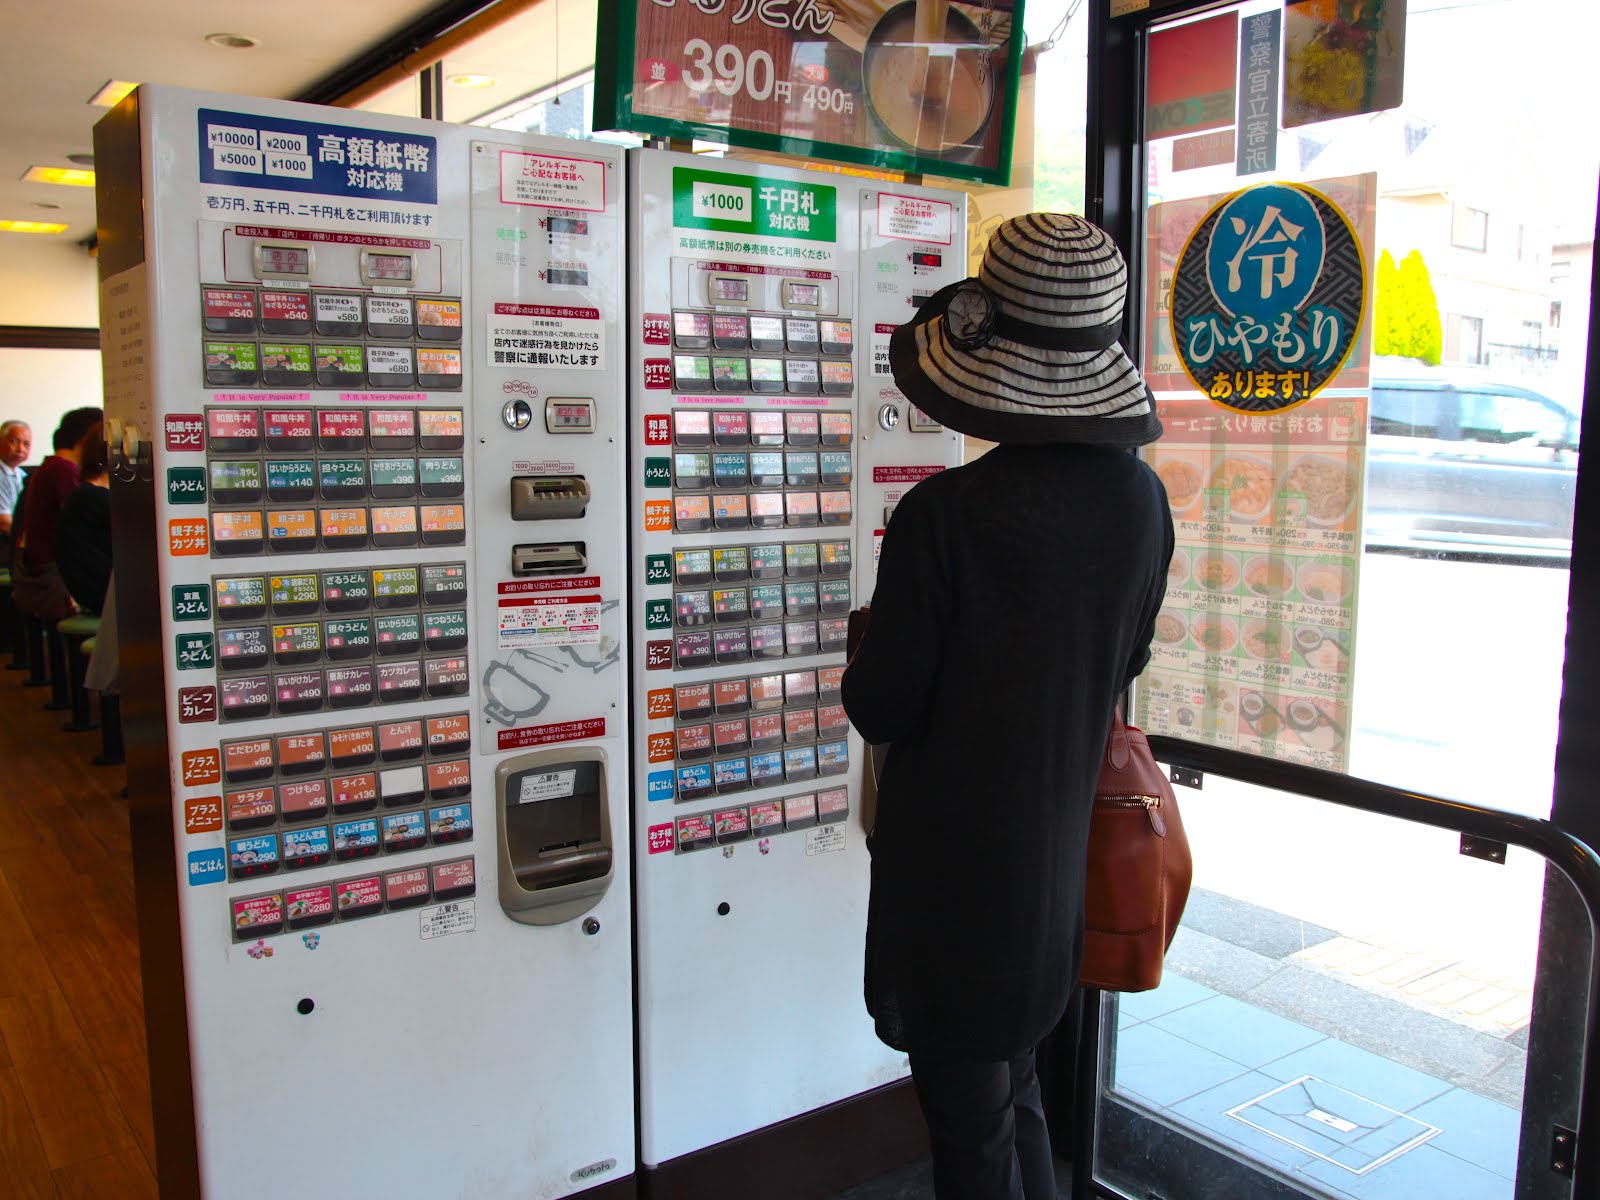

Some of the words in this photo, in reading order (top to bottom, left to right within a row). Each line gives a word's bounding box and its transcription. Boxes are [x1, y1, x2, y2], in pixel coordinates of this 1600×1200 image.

[651, 62, 665, 80] 並
[211, 132, 254, 145] ¥10000
[267, 139, 301, 151] ¥2000
[318, 134, 429, 173] 高額紙幣
[221, 154, 256, 166] ¥5000
[272, 159, 306, 171] ¥1000
[530, 159, 577, 171] アレルギーが
[522, 168, 585, 181] ご心配なお客様へ
[347, 169, 404, 192] 対応機
[701, 193, 744, 211] ¥1000
[758, 186, 820, 215] 千円札
[768, 213, 810, 231] 対応機
[679, 237, 831, 260] 高額紙幣は別の券売機をご利用ください
[1225, 205, 1305, 299] 冷
[644, 319, 670, 329] おすすめ
[645, 330, 670, 339] メニュー
[1189, 309, 1339, 366] ひやもり
[494, 339, 599, 350] 店内で迷惑行為を見かけたら
[494, 351, 599, 365] 警察に通報いたします
[389, 365, 409, 373] ¥680
[644, 364, 671, 374] おすすめ
[646, 376, 670, 384] メニュー
[1211, 371, 1311, 399] あります!
[272, 414, 305, 423] 和風牛丼
[166, 422, 203, 433] 和風牛丼
[649, 420, 668, 429] 和風
[288, 428, 311, 437] ¥250
[341, 428, 363, 436] ¥390
[649, 430, 668, 440] 牛丼
[170, 434, 200, 444] コンビ
[269, 464, 311, 473] はいからうどん
[646, 468, 670, 478] 小うどん
[235, 479, 258, 488] ¥140
[290, 479, 313, 487] ¥140
[342, 477, 363, 486] ¥250
[392, 475, 414, 484] ¥390
[441, 475, 461, 483] ¥390
[170, 480, 205, 492] 小うどん
[646, 505, 670, 515] 親子丼
[647, 517, 670, 526] カツ丼
[171, 525, 205, 536] 親子丼
[172, 538, 206, 549] カツ丼
[648, 569, 670, 578] うどん
[326, 575, 365, 584] ざるうどん
[395, 585, 415, 593] ¥290
[504, 579, 595, 592] お釣りの取り忘れにご注意ください
[183, 592, 200, 601] 京風
[293, 592, 315, 601] ¥290
[345, 588, 367, 597] ¥390
[176, 603, 208, 613] うどん
[427, 615, 463, 624] きつねうどん
[649, 614, 670, 623] うどん
[379, 619, 417, 629] はいからうどん
[397, 632, 417, 640] ¥280
[445, 627, 465, 636] ¥390
[187, 640, 203, 649] 京風
[243, 645, 266, 654] ¥490
[296, 641, 318, 649] ¥490
[649, 646, 670, 654] ビーフ
[180, 651, 211, 661] うどん
[649, 655, 670, 664] カレー
[380, 667, 418, 677] カツカレー
[428, 663, 446, 671] カレー
[277, 675, 320, 686] あいがけカレー
[223, 681, 266, 691] ビーフカレー
[350, 683, 371, 692] ¥490
[298, 689, 320, 697] ¥490
[182, 694, 213, 705] ビーフ
[244, 694, 268, 704] ¥390
[651, 694, 671, 704] プラス
[183, 705, 213, 716] カレー
[649, 705, 673, 714] メニュー
[389, 726, 413, 736] とん汁
[448, 731, 468, 740] ¥300
[684, 728, 703, 736] サラダ
[288, 738, 314, 748] 温たま
[651, 738, 671, 748] プラス
[228, 743, 270, 755] こだわり卵
[352, 744, 373, 753] ¥100
[649, 749, 673, 758] メニュー
[254, 756, 271, 765] ¥60
[306, 751, 323, 760] ¥80
[187, 756, 215, 768] プラス
[184, 769, 219, 780] メニュー
[342, 777, 366, 788] ライス
[448, 776, 468, 786] ¥120
[649, 781, 673, 791] 朝ごはん
[287, 784, 320, 795] つけもの
[237, 791, 264, 802] サラダ
[354, 790, 375, 800] ¥130
[309, 797, 325, 807] ¥50
[190, 804, 218, 816] プラス
[250, 804, 273, 815] ¥100
[187, 817, 221, 827] メニュー
[337, 823, 375, 835] とん汁定食
[650, 828, 672, 840] お子様
[237, 840, 270, 851] 朝うどん
[651, 838, 671, 849] セット
[190, 860, 224, 874] 朝ごはん
[454, 876, 473, 885] ¥280
[407, 884, 427, 895] ¥100
[359, 894, 380, 904] ¥280
[309, 903, 330, 913] ¥280
[445, 904, 459, 912] 警告
[258, 913, 280, 922] ¥280
[578, 1164, 610, 1178] Kubota
